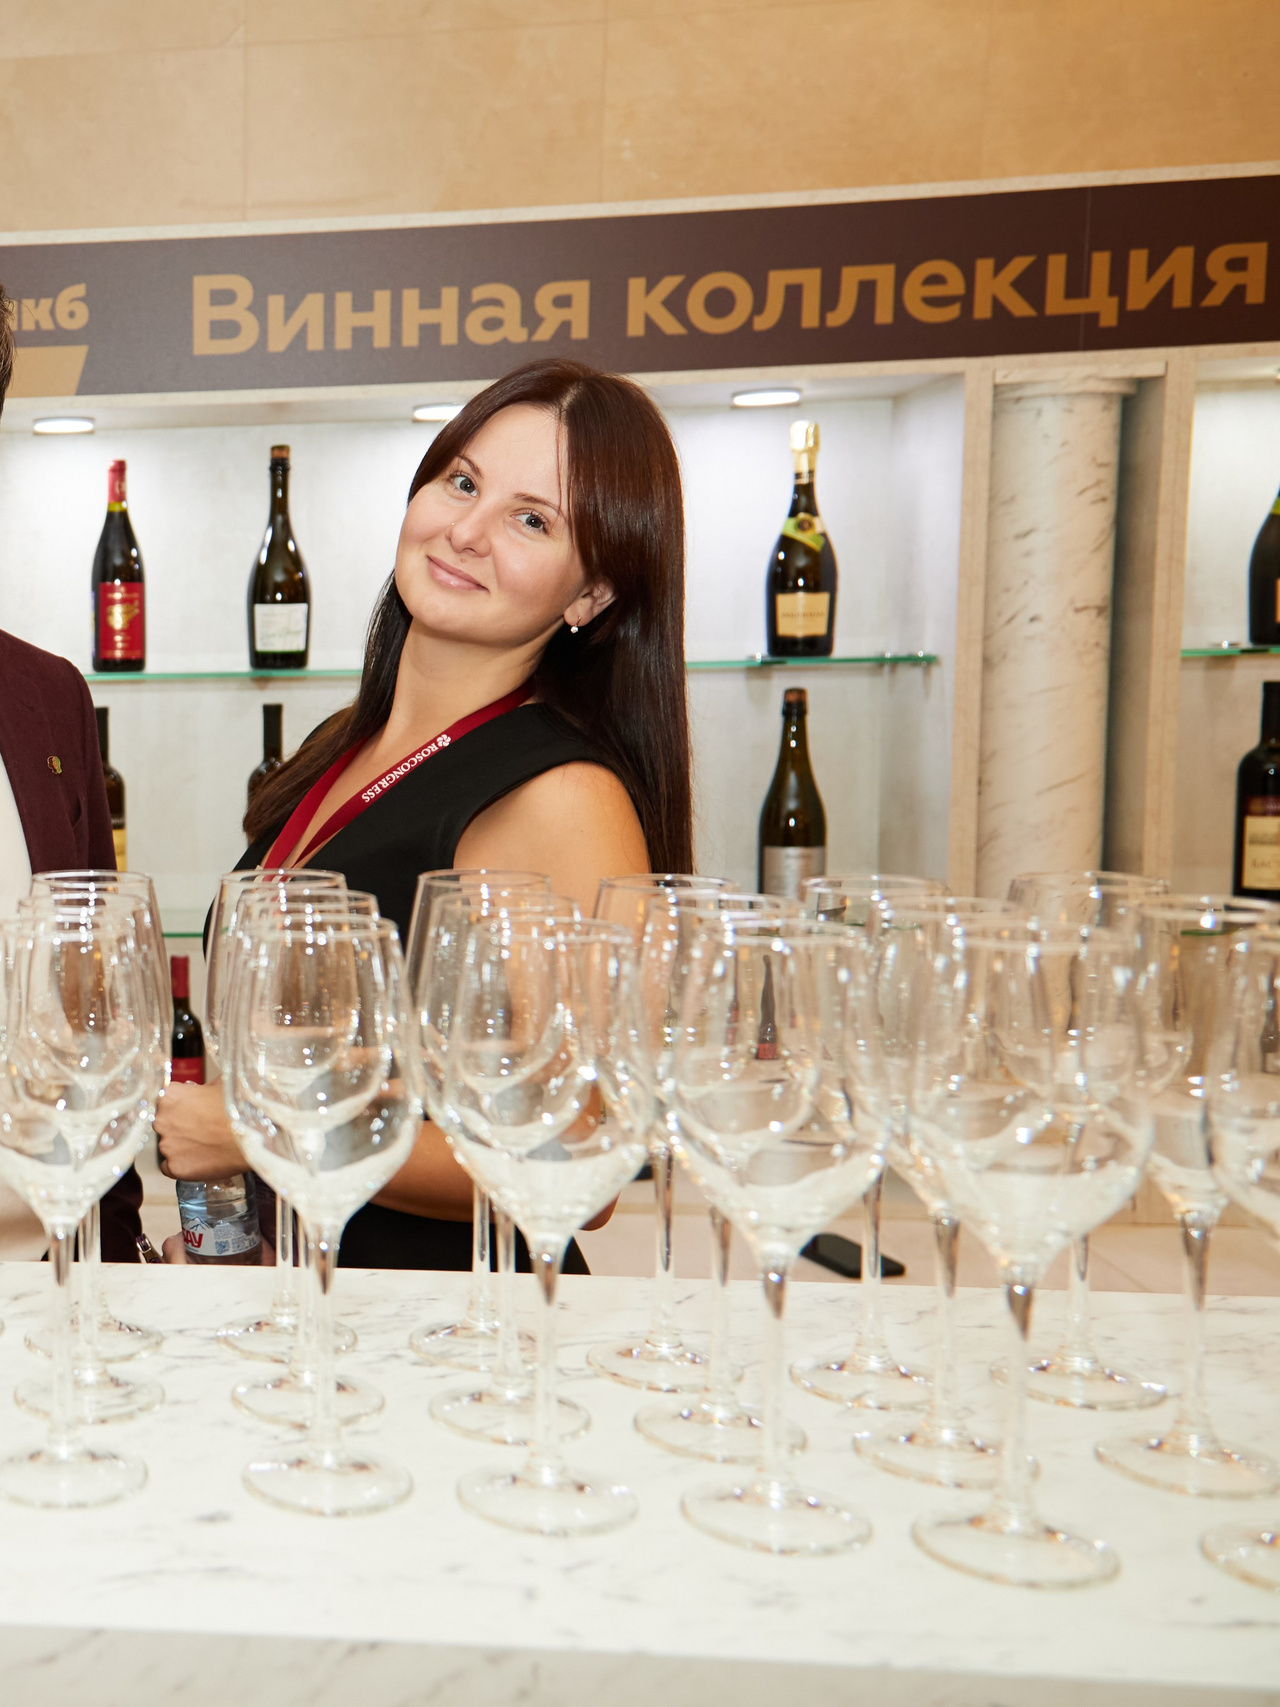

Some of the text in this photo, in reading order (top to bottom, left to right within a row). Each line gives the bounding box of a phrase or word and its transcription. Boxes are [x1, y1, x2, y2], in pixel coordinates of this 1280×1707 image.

[192, 241, 1269, 356] Винная коллекция
[361, 742, 439, 803] ROSCONGRESS
